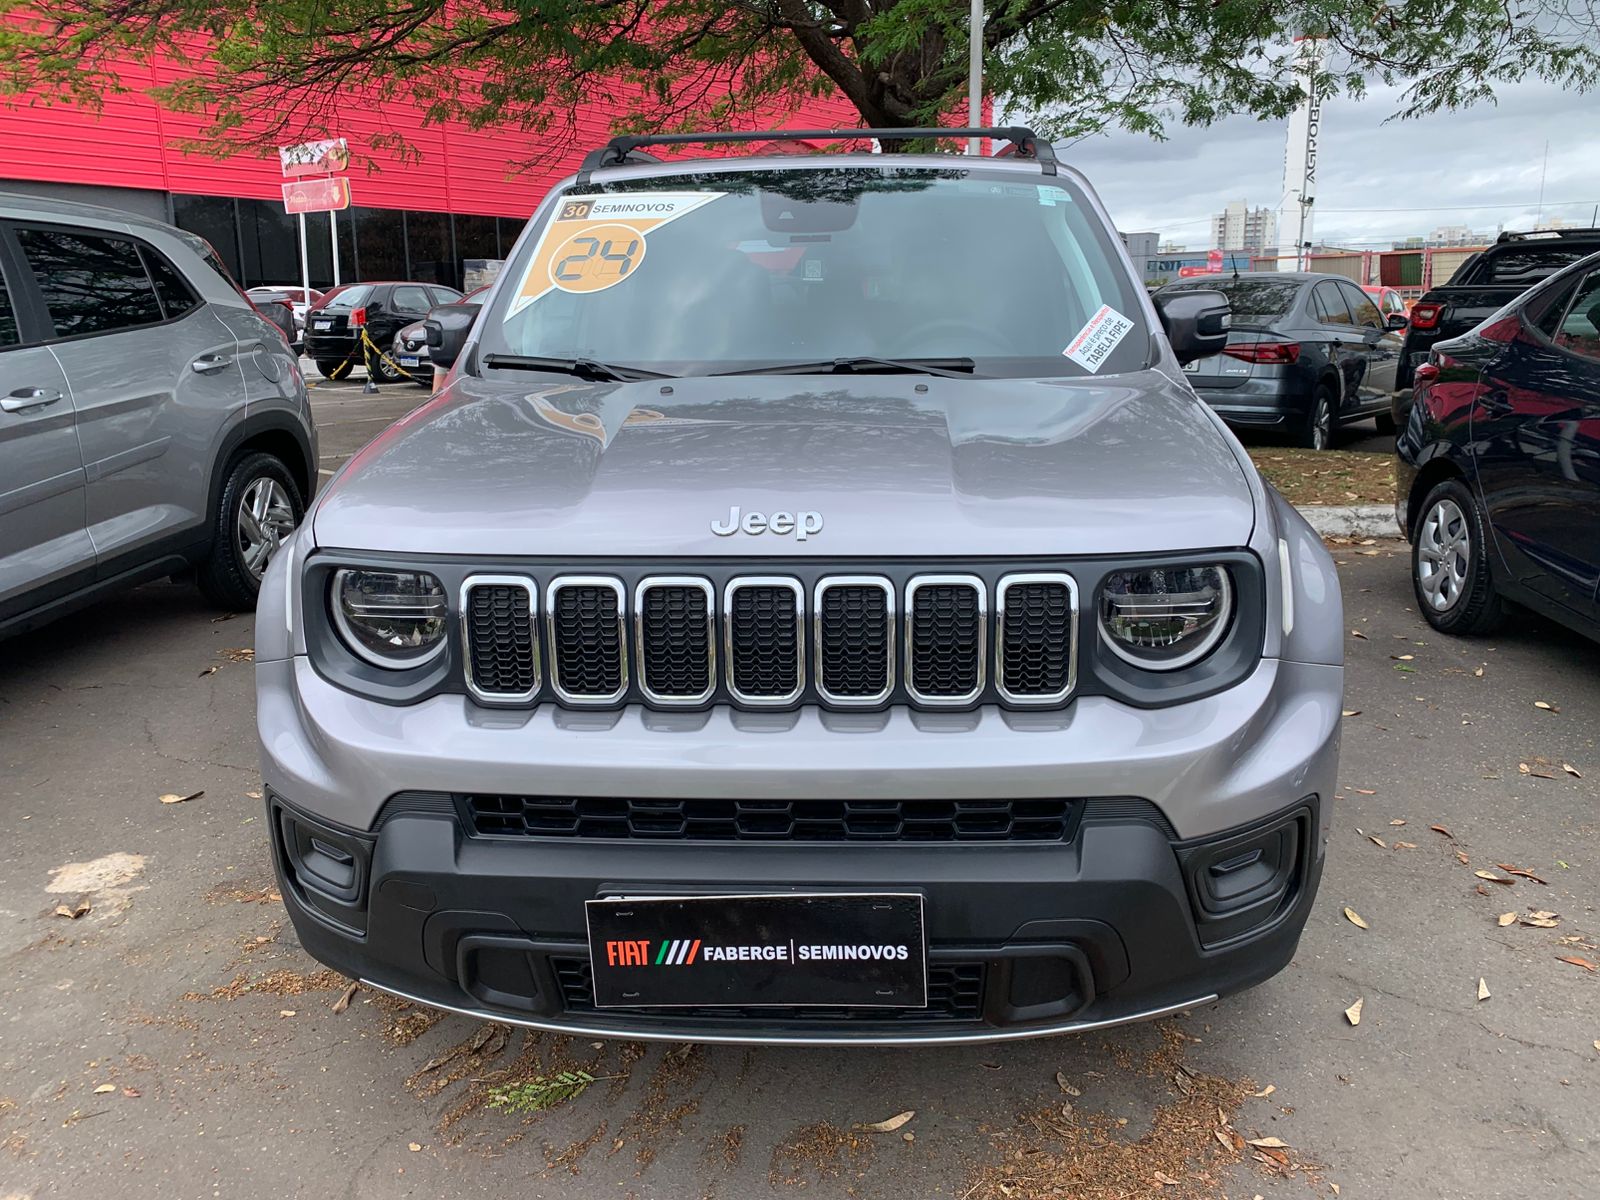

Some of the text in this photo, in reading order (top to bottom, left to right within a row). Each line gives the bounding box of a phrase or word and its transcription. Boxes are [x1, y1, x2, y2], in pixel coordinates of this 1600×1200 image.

[563, 202, 675, 218] 30 SEMINOVOS
[555, 236, 639, 281] 24
[1078, 340, 1093, 356] Aqui
[1093, 324, 1109, 341] preço
[1104, 316, 1114, 325] de
[1086, 320, 1127, 365] TABELA FIPE
[710, 505, 824, 541] Jeep
[606, 940, 909, 966] FIAT FABERGE SEMINOVOS
